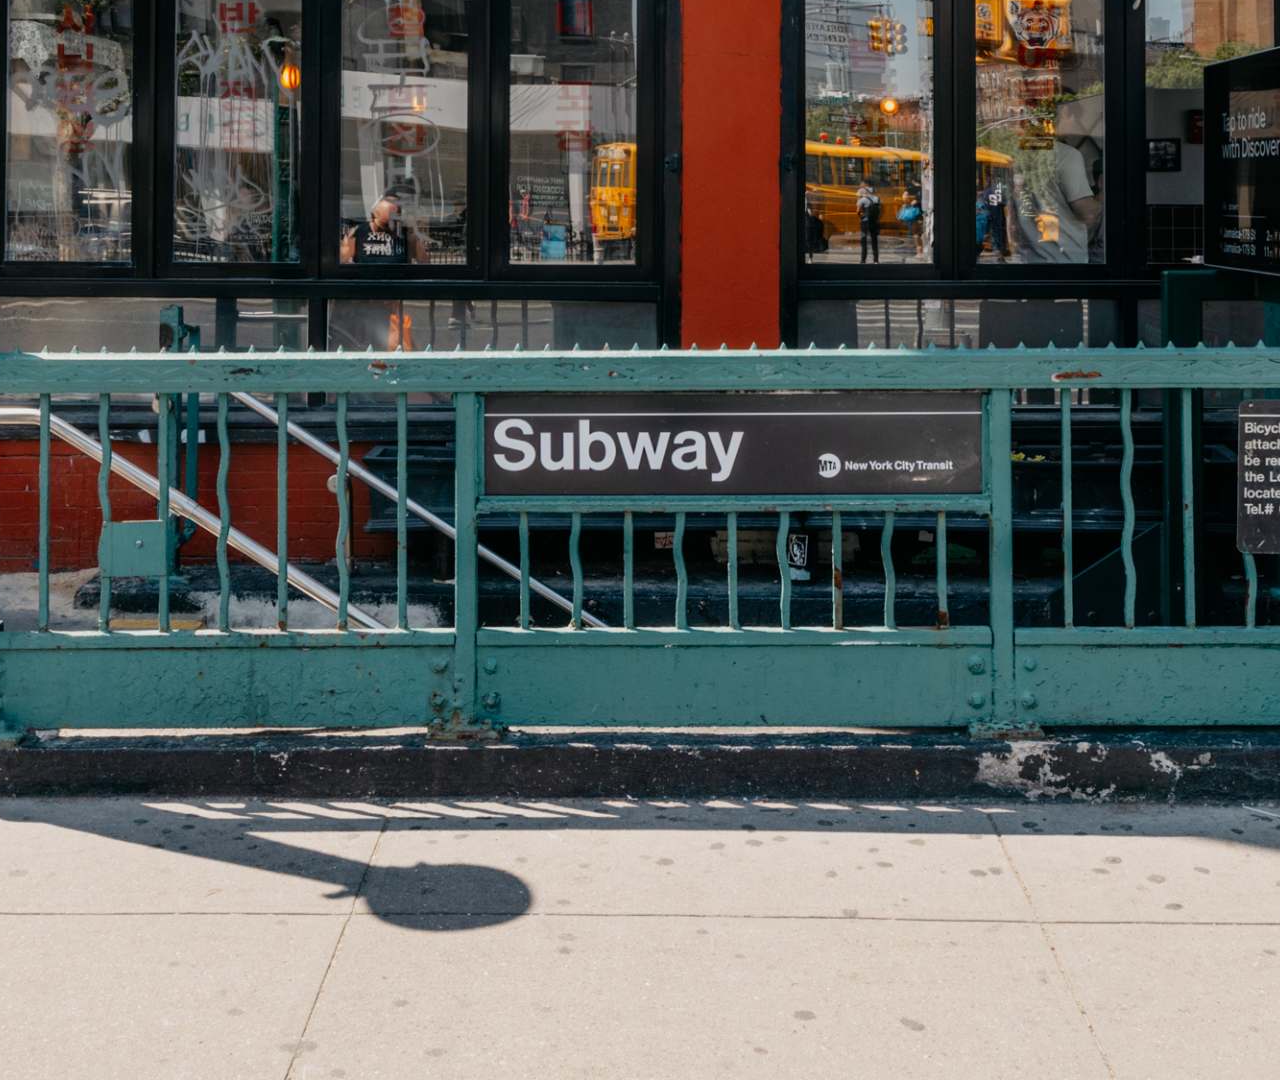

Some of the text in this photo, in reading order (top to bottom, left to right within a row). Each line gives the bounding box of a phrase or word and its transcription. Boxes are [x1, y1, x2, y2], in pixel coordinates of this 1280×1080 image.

[1223, 109, 1267, 133] Tap to ride
[1222, 137, 1280, 159] with Discover
[493, 418, 744, 482] Subway
[845, 460, 953, 473] New York City Transit
[1244, 456, 1261, 467] be
[1245, 472, 1264, 483] the
[1245, 503, 1274, 515] Tel.#
